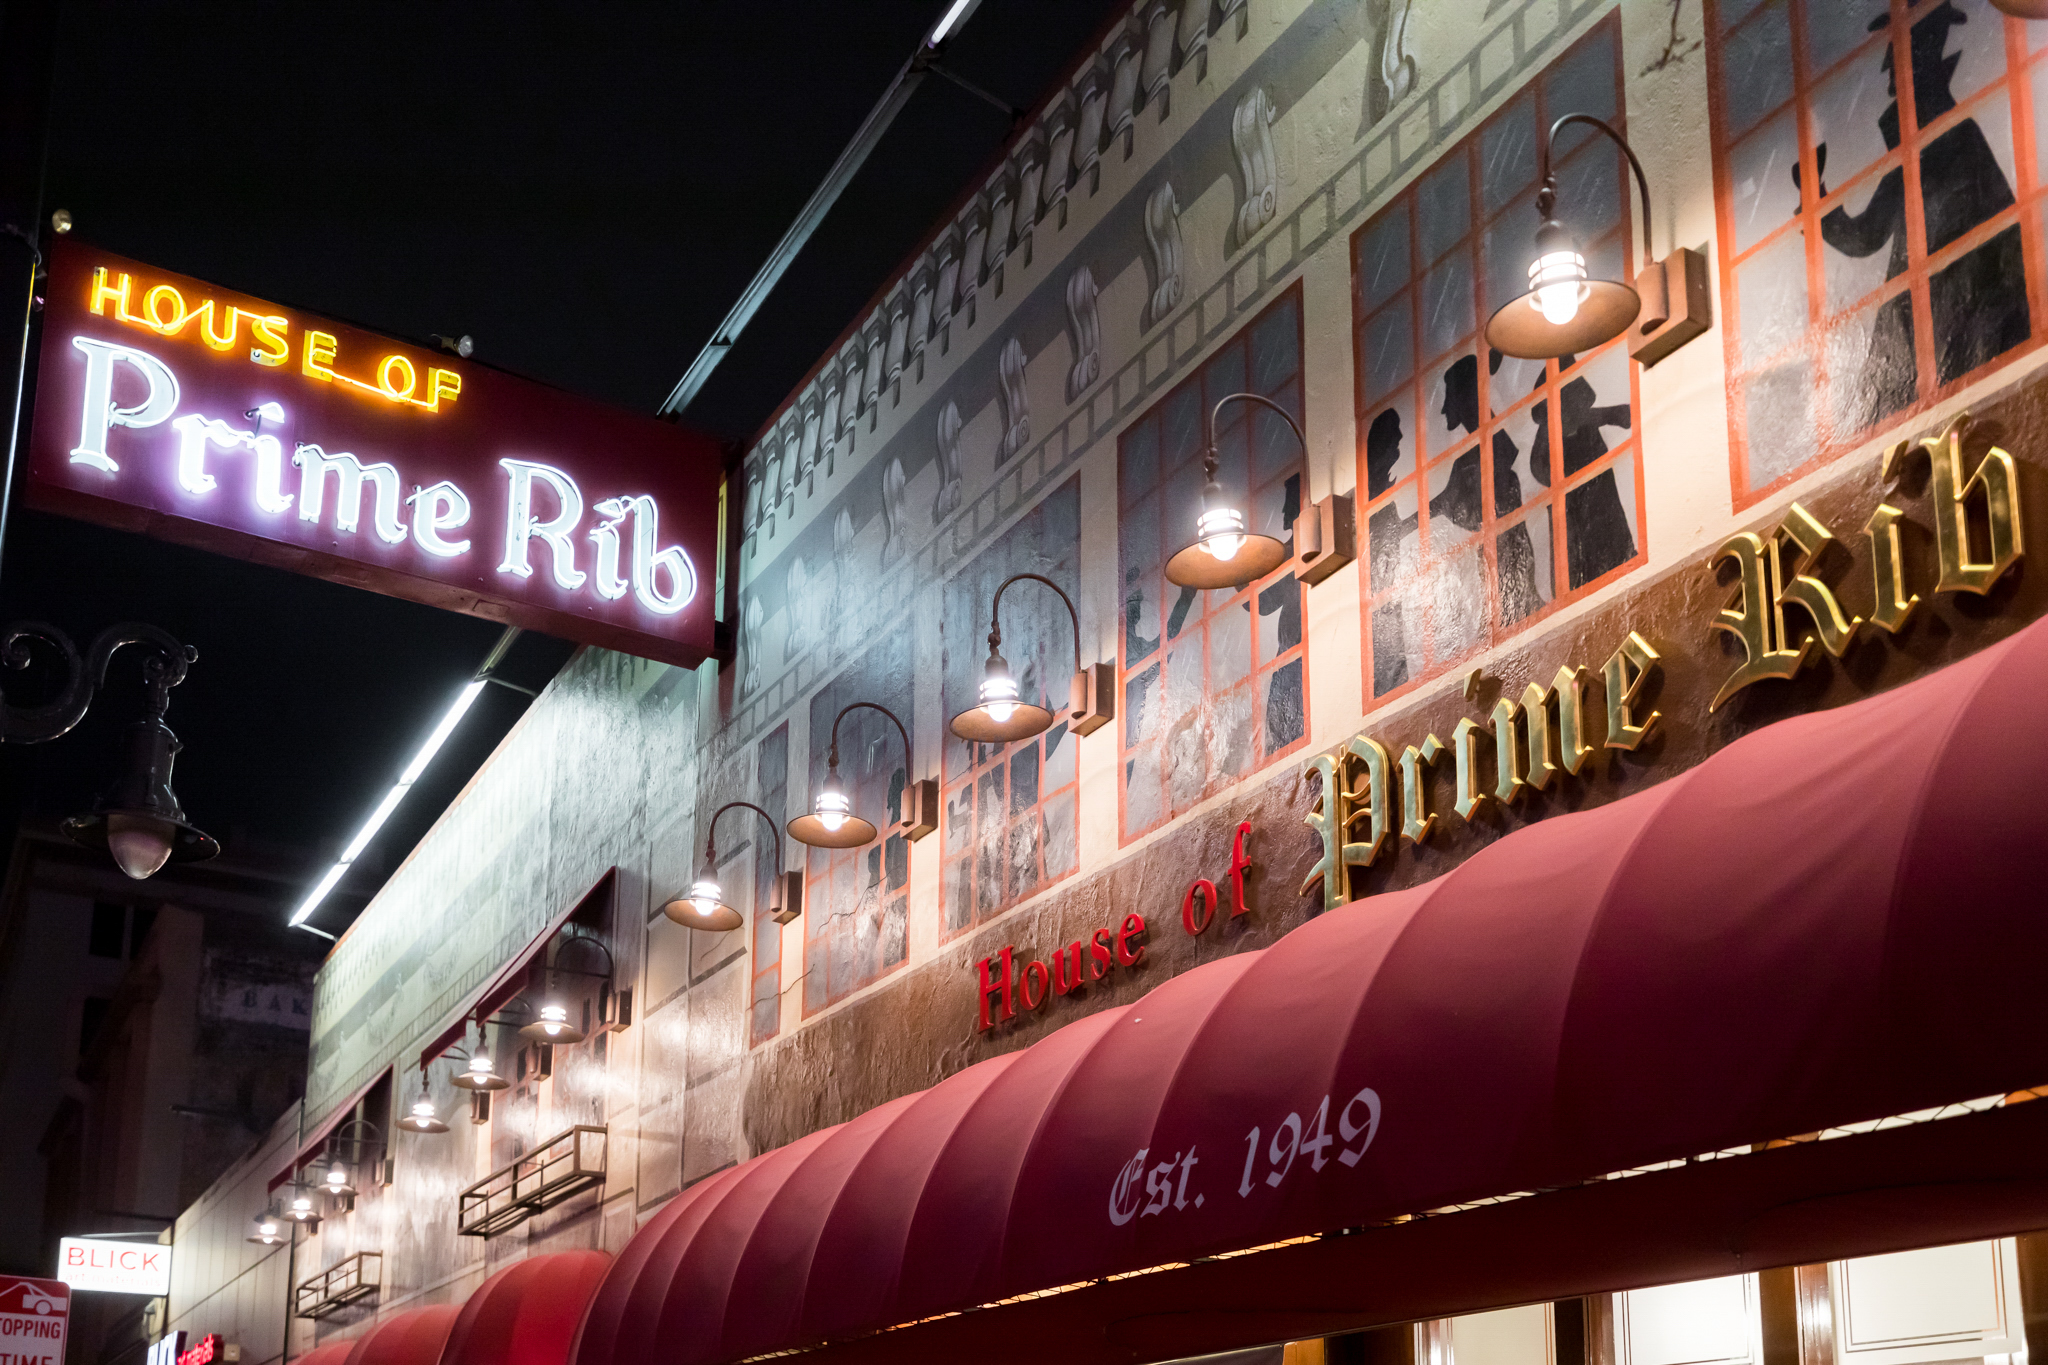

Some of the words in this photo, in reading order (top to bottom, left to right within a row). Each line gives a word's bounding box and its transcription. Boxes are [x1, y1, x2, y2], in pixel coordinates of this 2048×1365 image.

[90, 266, 338, 380] HOUSE
[376, 354, 462, 412] OF
[69, 335, 472, 557] Prime
[496, 457, 698, 615] Rib
[975, 913, 1145, 1034] House
[1182, 821, 1252, 936] of
[1300, 630, 1662, 912] Prime
[1706, 411, 2026, 714] Rib
[1108, 1144, 1205, 1226] Est.
[1238, 1087, 1381, 1198] 1949
[0, 1317, 61, 1340] OPPING
[67, 1246, 159, 1272] BLICK
